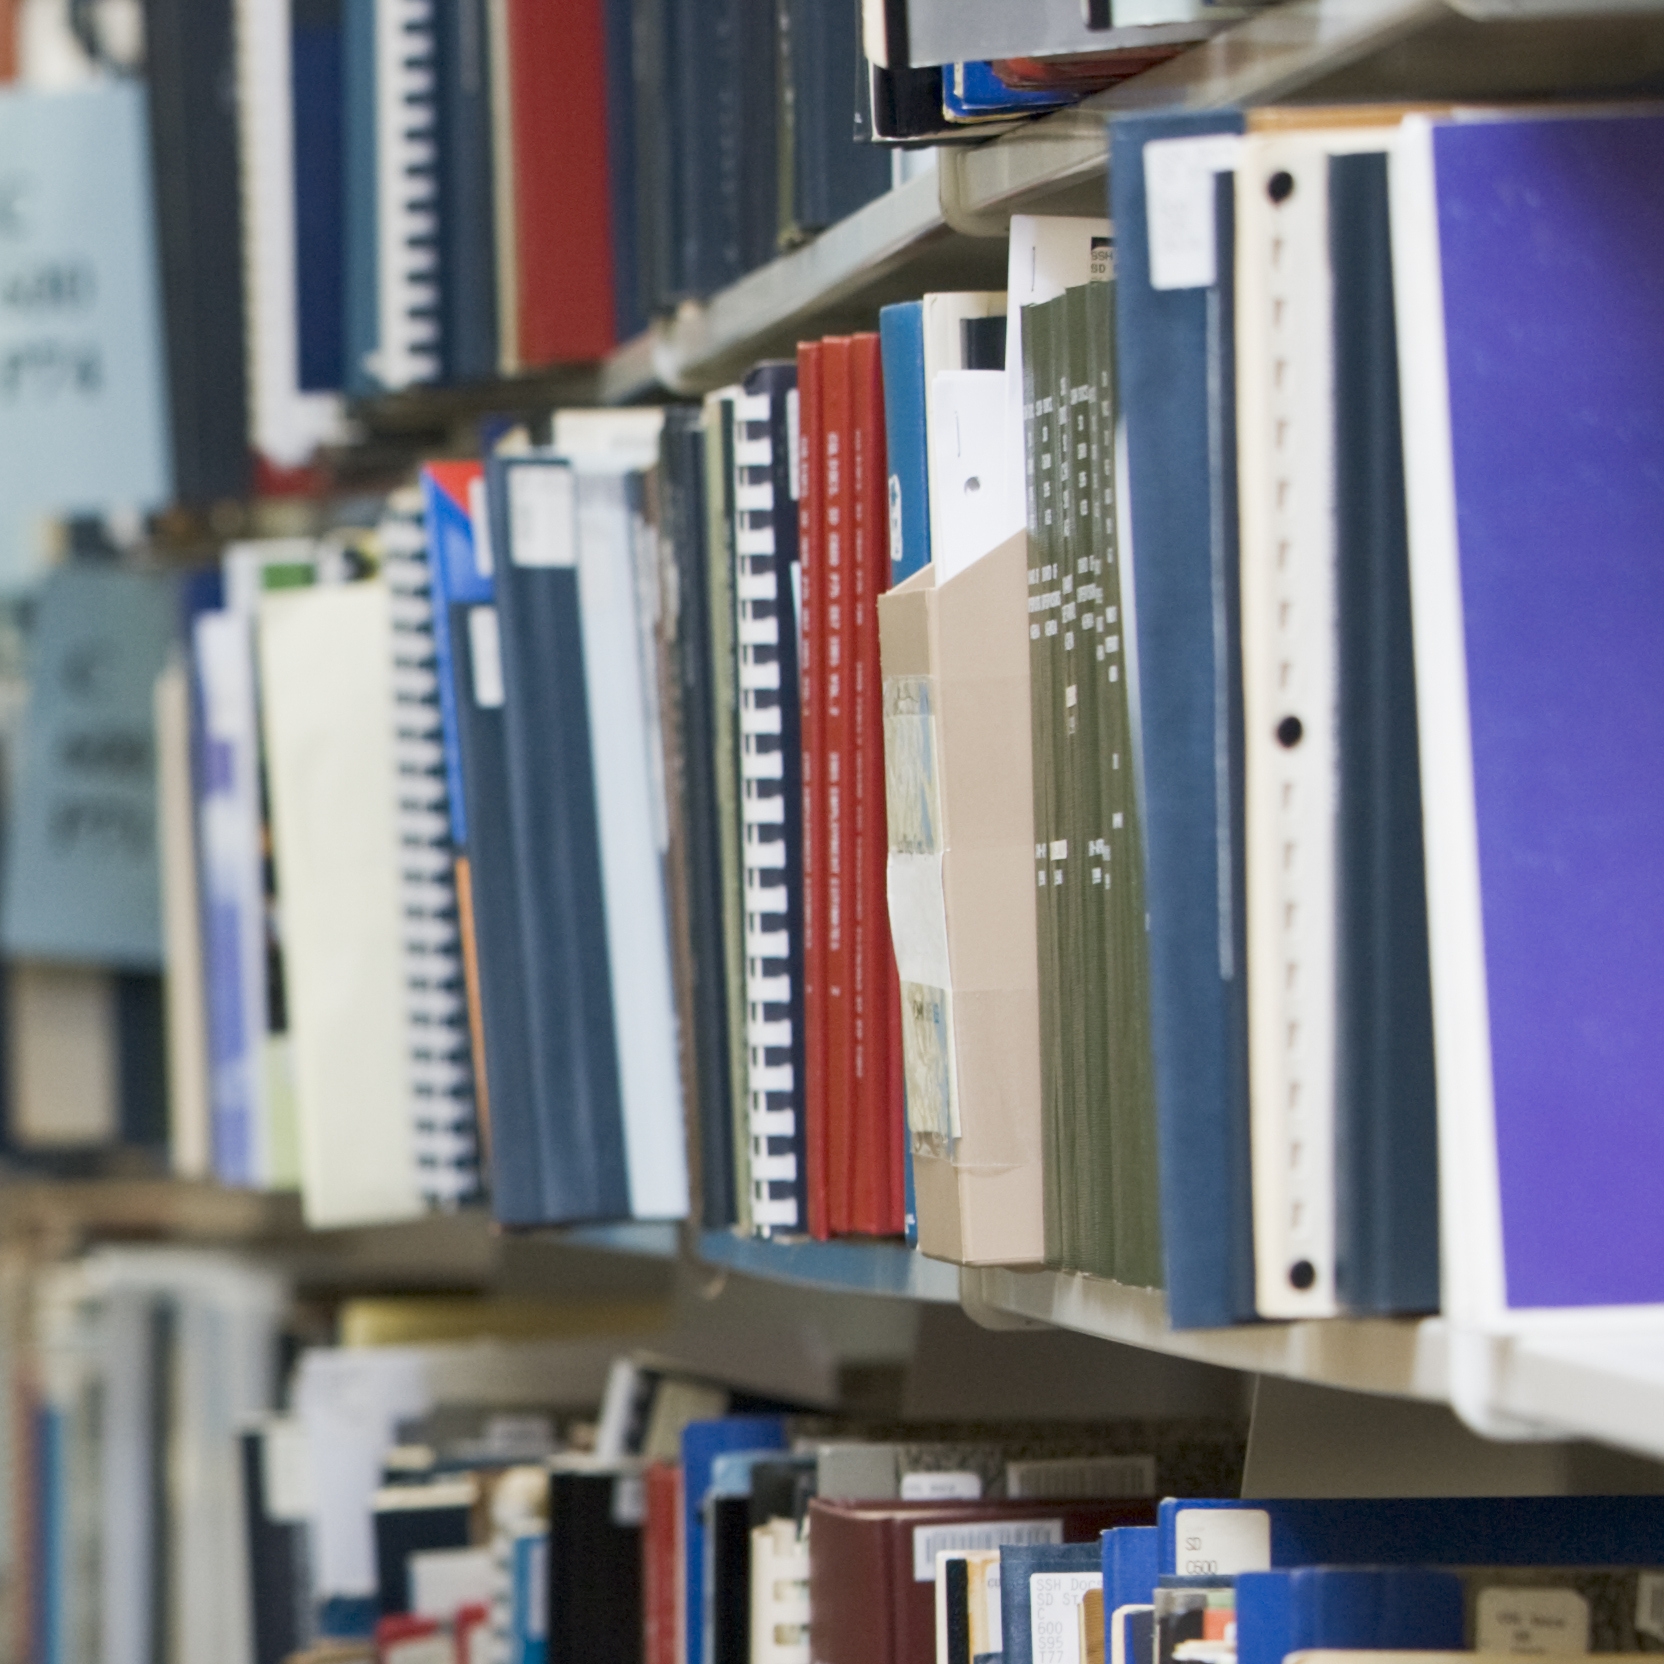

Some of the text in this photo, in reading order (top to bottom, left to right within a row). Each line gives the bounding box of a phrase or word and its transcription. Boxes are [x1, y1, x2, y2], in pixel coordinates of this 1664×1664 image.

[1036, 1578, 1061, 1591] SSH
[1037, 1593, 1054, 1606] SD
[1037, 1607, 1045, 1621] C
[1037, 1622, 1063, 1635] 600
[1038, 1636, 1064, 1650] S95
[1039, 1650, 1064, 1664] T77
